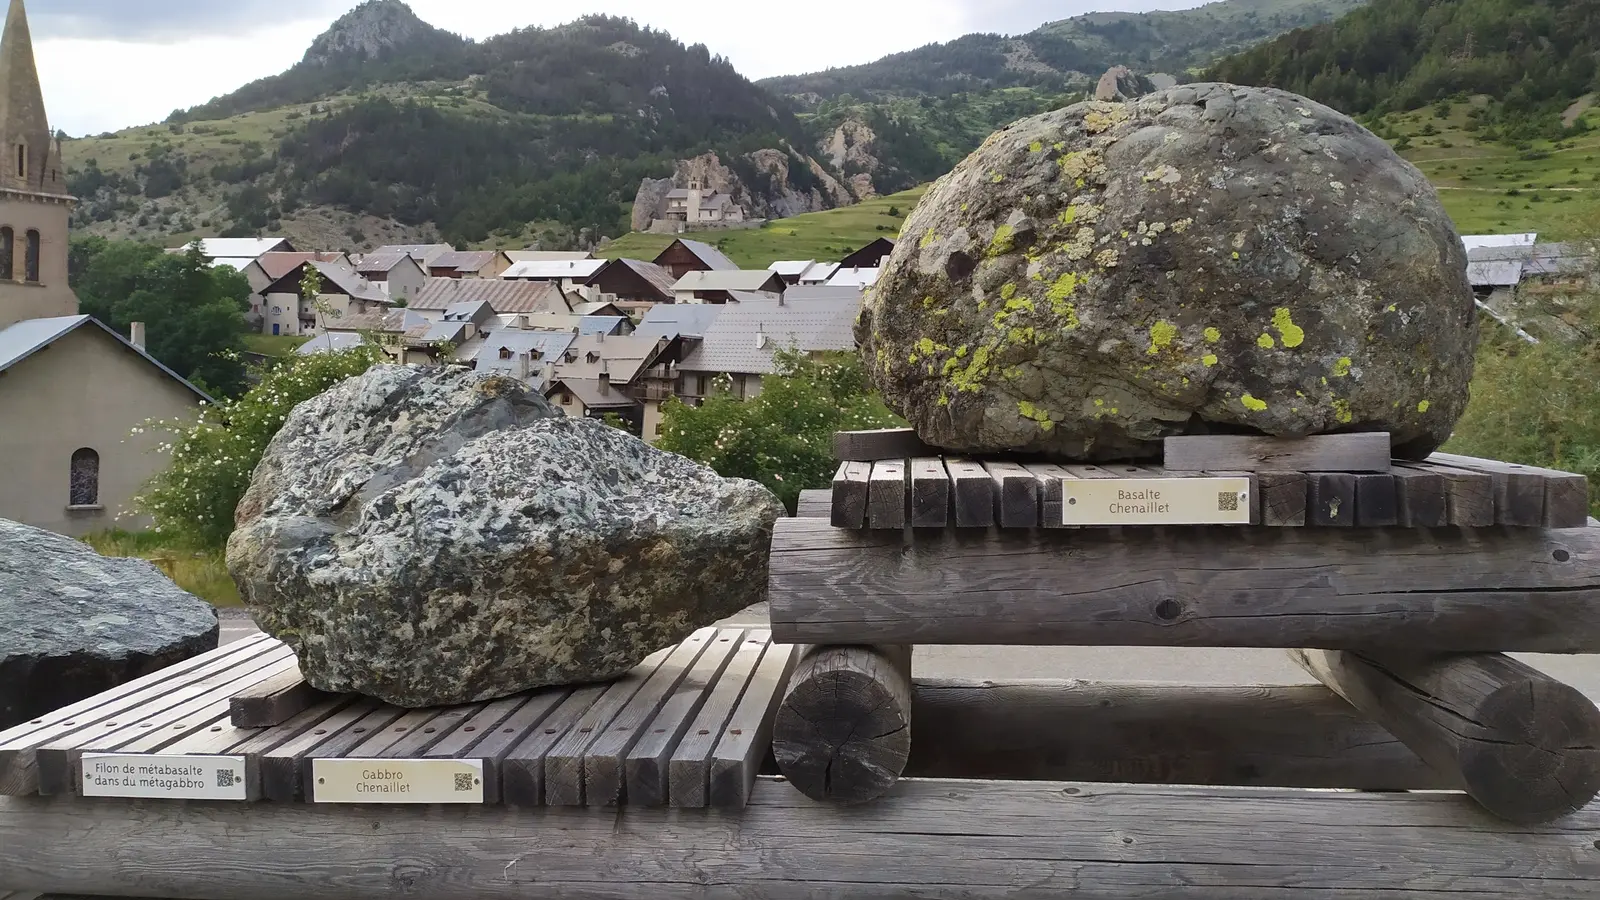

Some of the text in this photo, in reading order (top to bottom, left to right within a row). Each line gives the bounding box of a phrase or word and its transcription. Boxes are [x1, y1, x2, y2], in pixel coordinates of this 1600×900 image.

[1118, 489, 1161, 500] Basalte
[1109, 502, 1170, 514] Chenaillet
[95, 763, 203, 776] Filon de métabasalte
[362, 769, 403, 780] Gabbro
[94, 775, 205, 790] dans du métagabbro
[356, 782, 410, 793] Chenaillet
